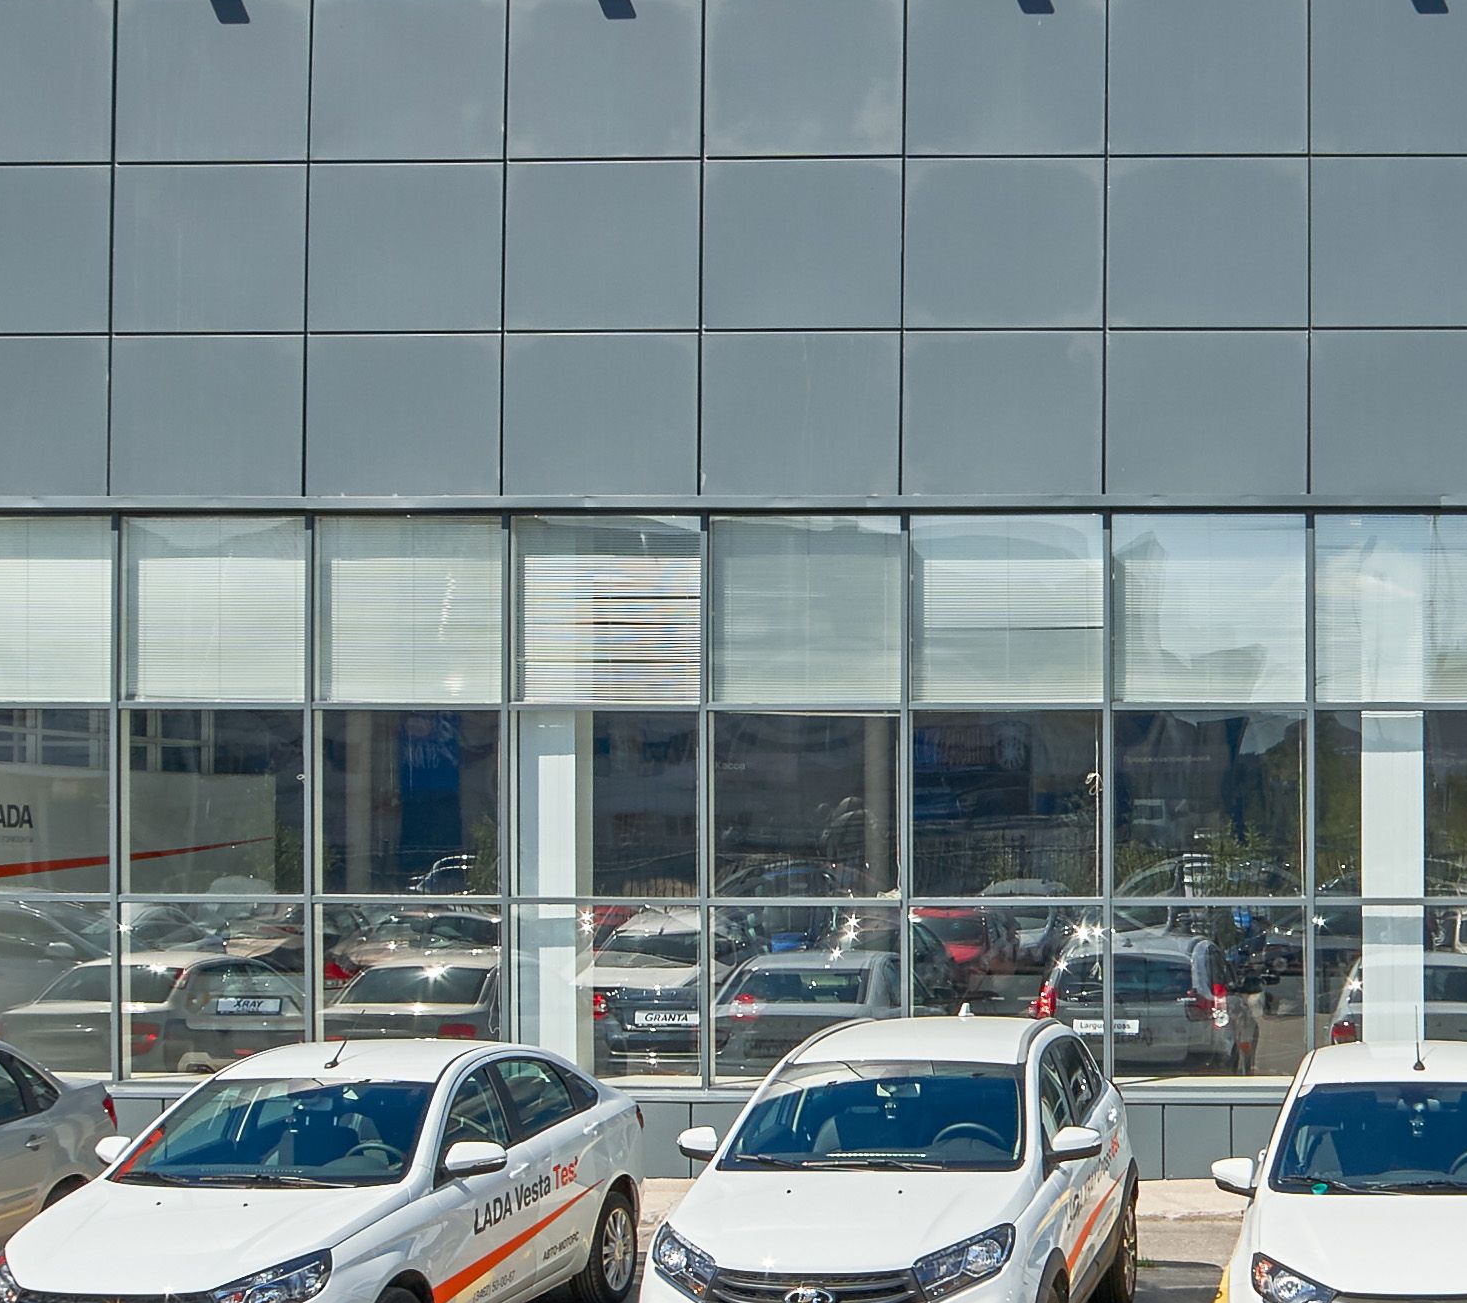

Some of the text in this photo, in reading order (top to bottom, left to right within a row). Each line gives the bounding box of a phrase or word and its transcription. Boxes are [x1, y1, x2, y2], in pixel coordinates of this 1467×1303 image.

[234, 999, 264, 1008] XRAY
[645, 1013, 688, 1022] GRANTA
[1080, 1022, 1103, 1030] Largu
[474, 1192, 512, 1235] LADA
[515, 1175, 551, 1211] Vesta
